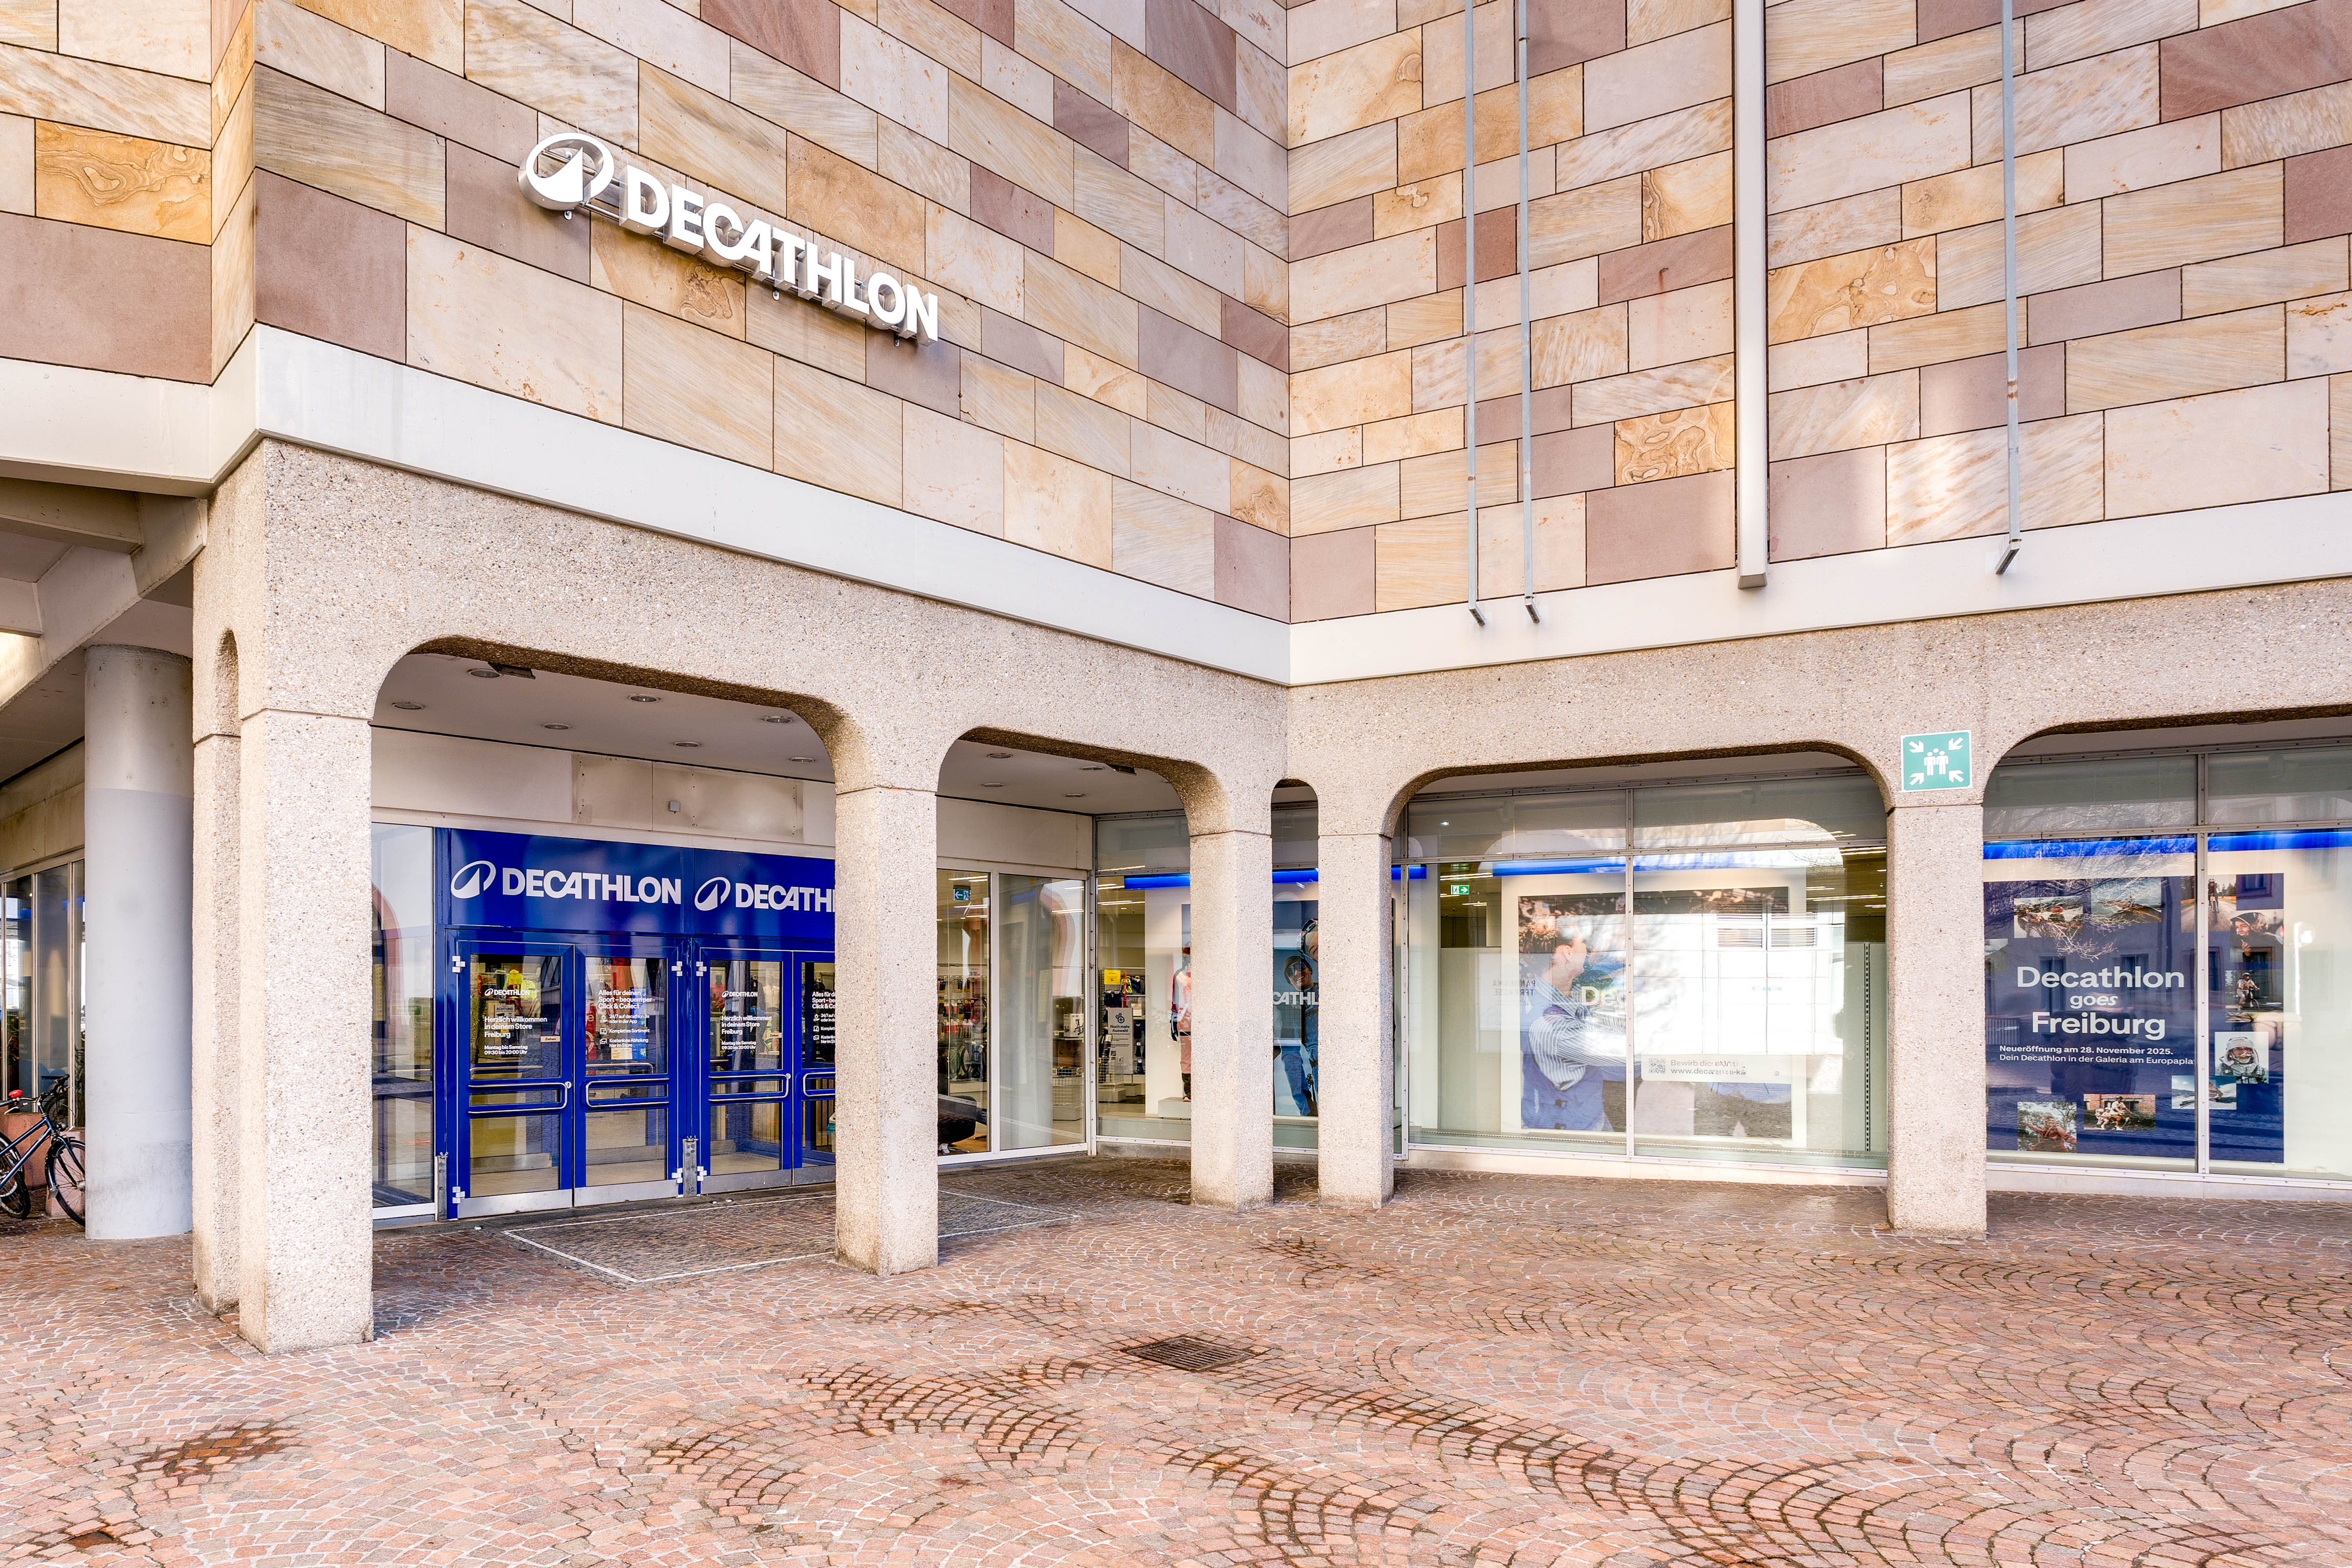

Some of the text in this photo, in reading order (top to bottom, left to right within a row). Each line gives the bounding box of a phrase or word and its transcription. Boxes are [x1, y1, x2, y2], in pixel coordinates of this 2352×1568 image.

[620, 165, 938, 345] DECATHLON
[502, 868, 681, 904] DECATHLON
[735, 882, 835, 912] DECATH
[2017, 966, 2184, 988] Decathlon
[1273, 992, 1319, 1005] CATHL
[2070, 995, 2118, 1009] goes
[2033, 1012, 2165, 1040] Freiburg
[2000, 1045, 2062, 1054] Neueröffnung
[2146, 1057, 2195, 1065] Europapla
